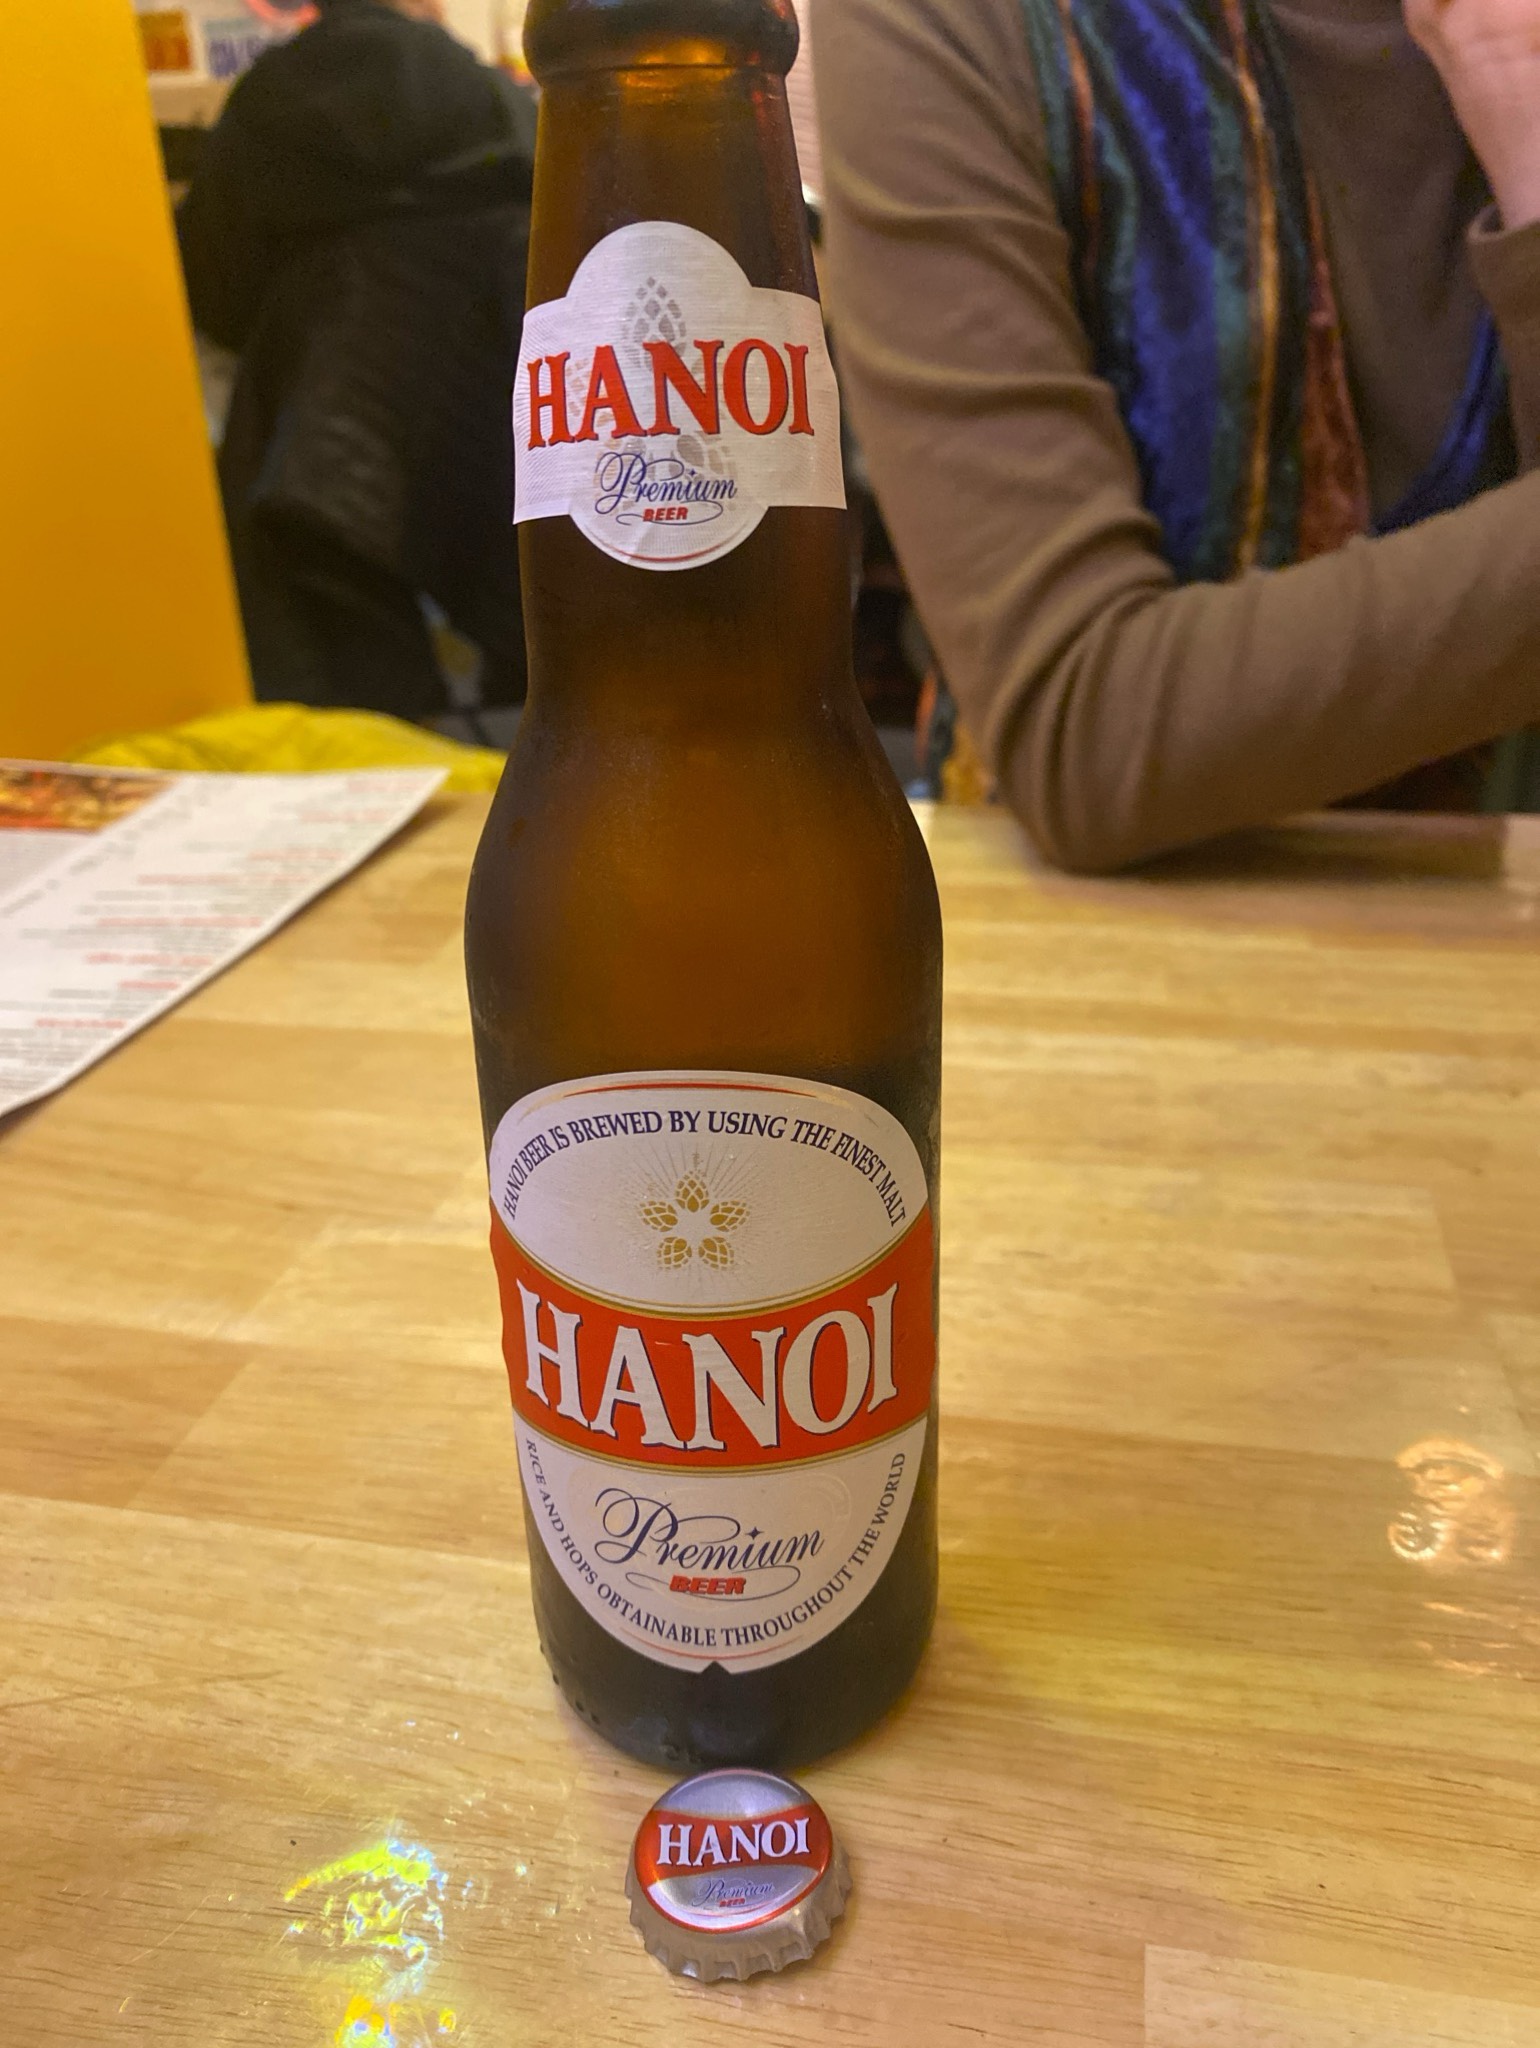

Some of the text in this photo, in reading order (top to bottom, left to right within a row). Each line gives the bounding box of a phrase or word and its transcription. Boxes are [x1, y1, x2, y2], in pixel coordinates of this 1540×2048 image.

[527, 338, 815, 451] HANOI
[595, 452, 738, 514] Premium
[642, 506, 688, 522] BEER
[504, 1110, 906, 1227] HANOI BEER IS BREWED BY USING THE FINEST MALT
[516, 1278, 899, 1452] HANOI
[526, 1438, 906, 1648] RICE AND HOPS OBTAINABLE THROUGHOUT THE WORLD
[594, 1487, 826, 1571] Premium
[669, 1574, 747, 1595] BEER
[656, 1817, 811, 1867] HANOI
[692, 1878, 775, 1908] Premium
